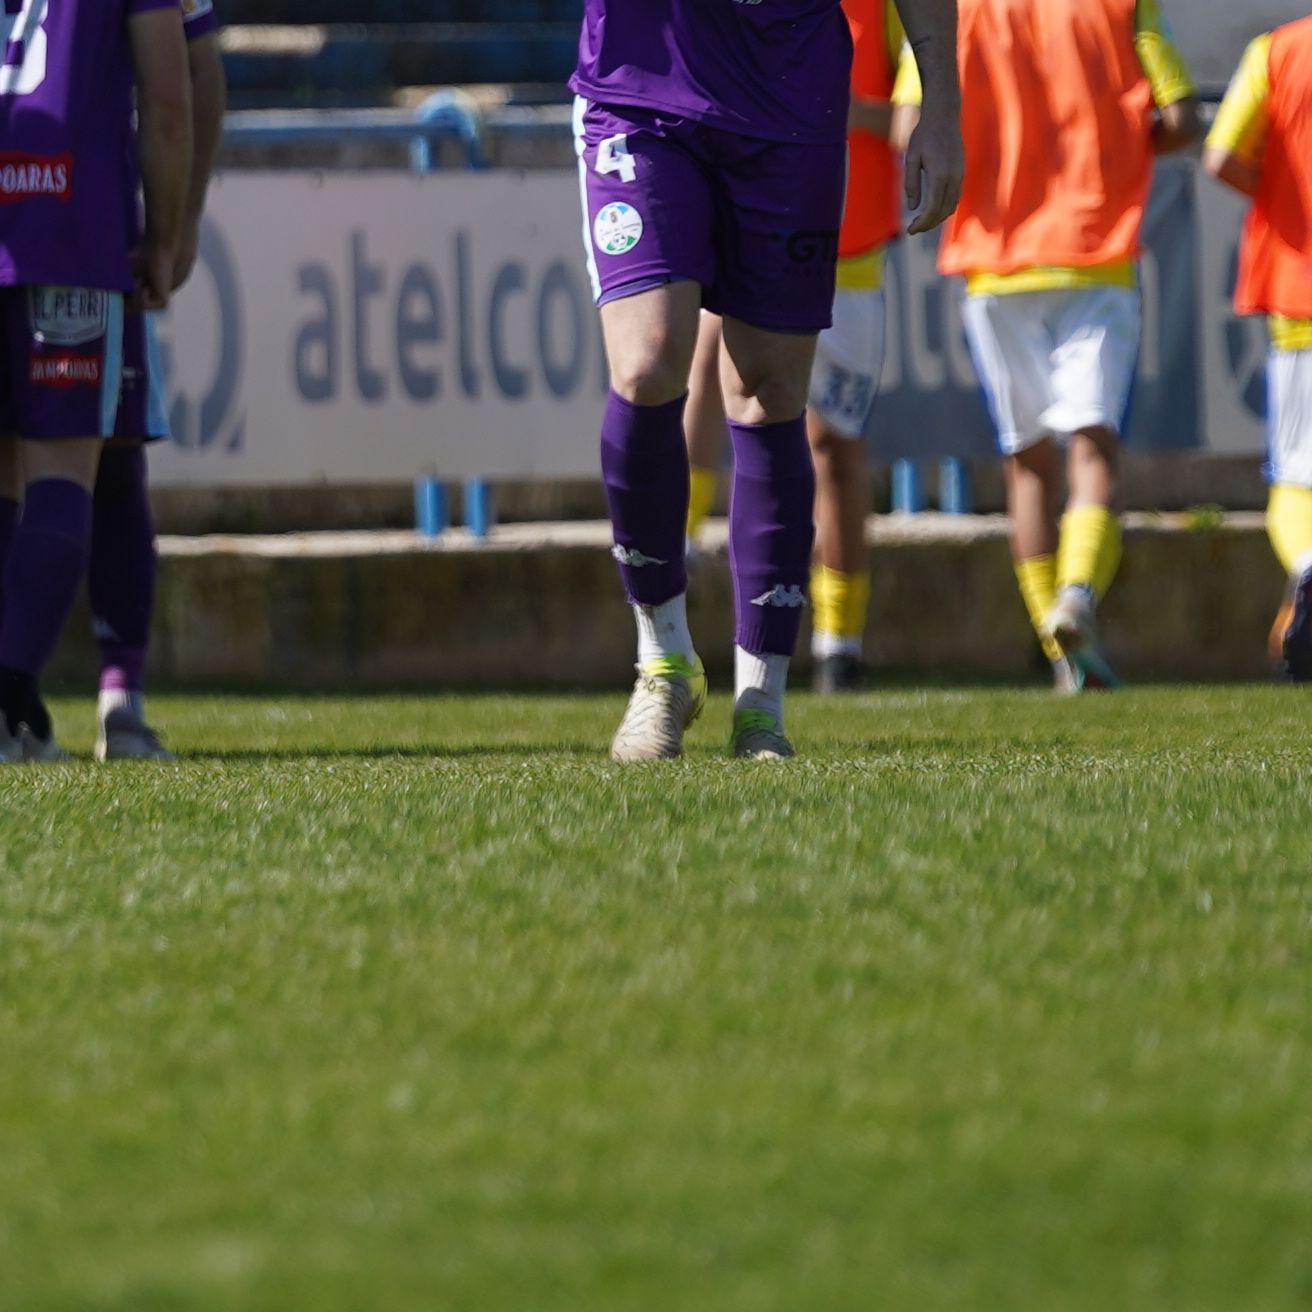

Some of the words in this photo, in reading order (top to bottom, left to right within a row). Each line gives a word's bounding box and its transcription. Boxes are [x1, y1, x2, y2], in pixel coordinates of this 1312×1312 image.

[595, 134, 636, 183] 4
[786, 230, 837, 264] GT
[293, 223, 609, 407] atelco
